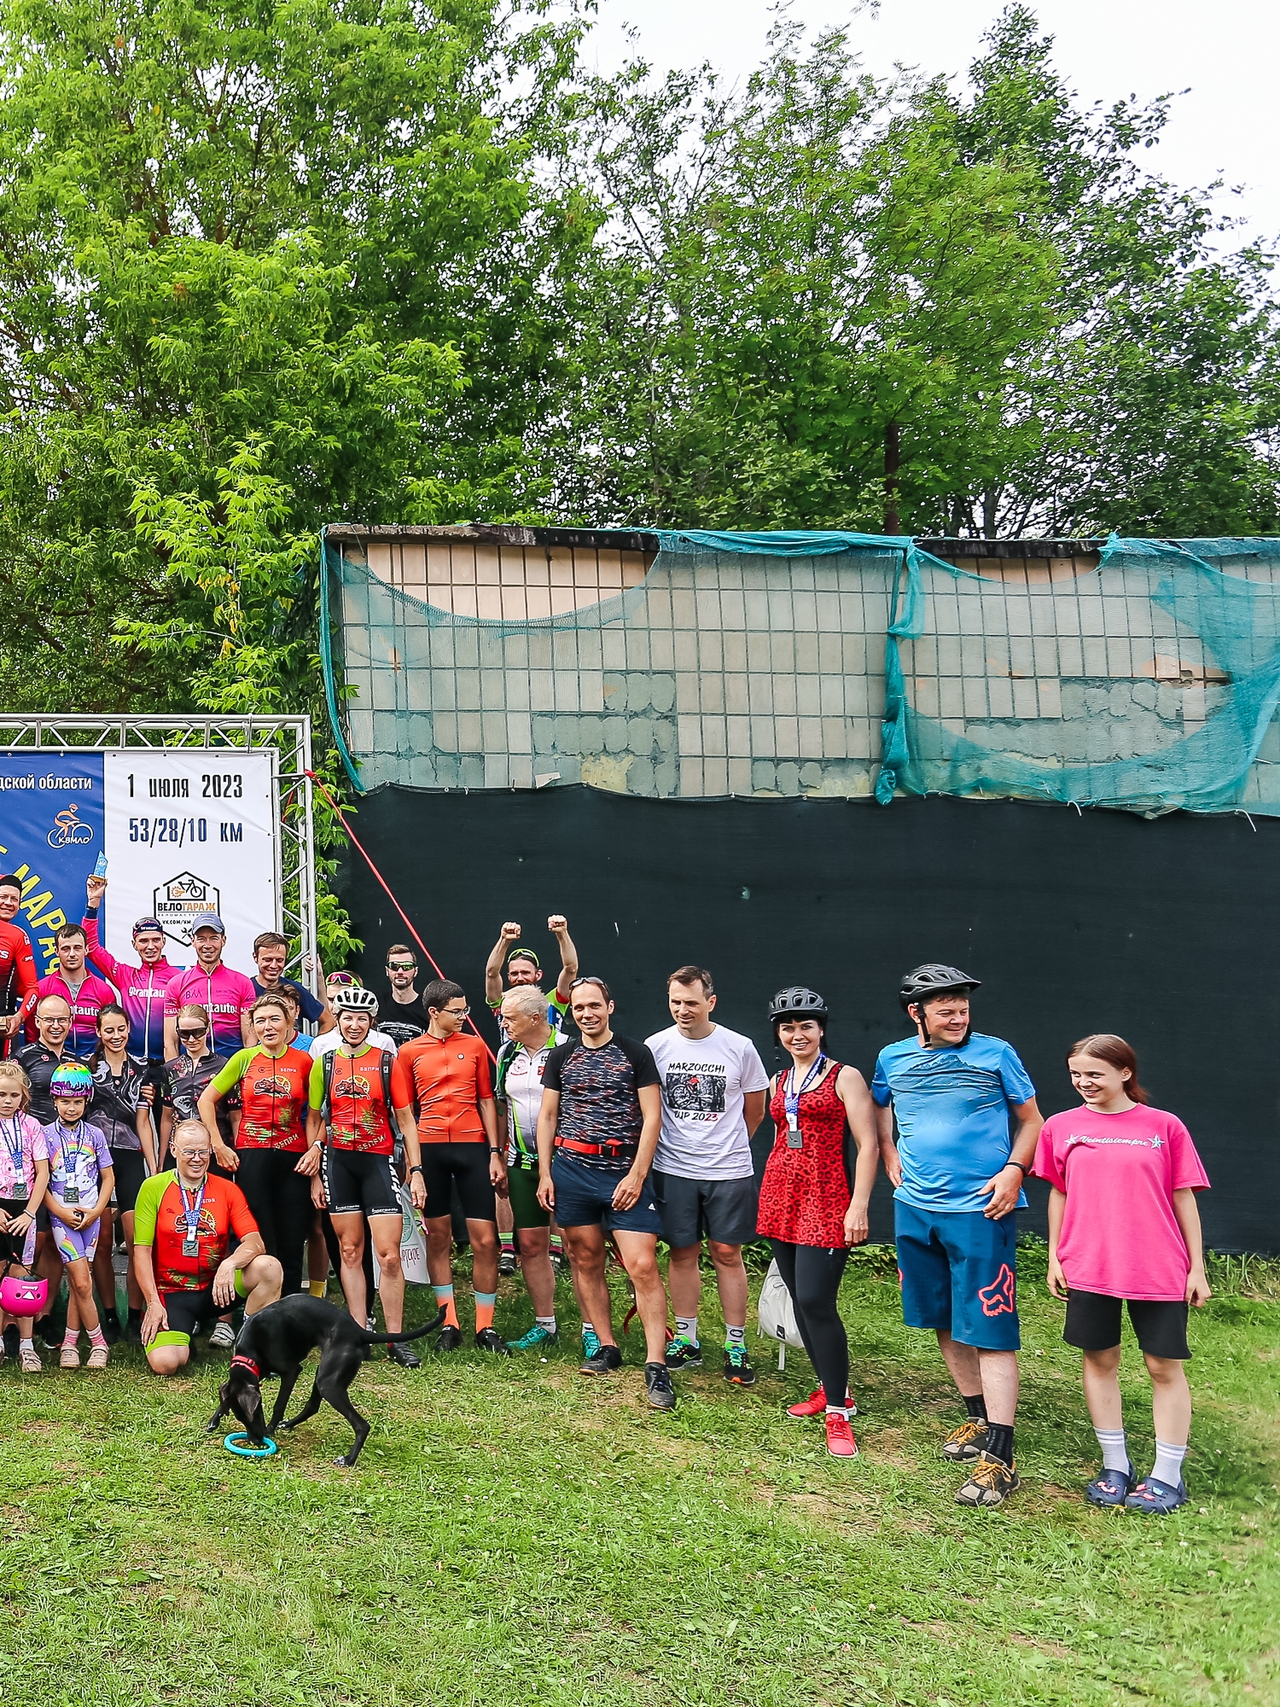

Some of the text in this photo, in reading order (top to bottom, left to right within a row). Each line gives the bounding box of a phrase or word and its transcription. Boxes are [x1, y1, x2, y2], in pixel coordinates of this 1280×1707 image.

[38, 773, 93, 790] области
[127, 774, 243, 798] 1 июля 2023
[129, 818, 208, 848] 53/28/10
[158, 902, 216, 911] ВЕЛОГАРАЖ
[668, 1062, 726, 1074] MARZOCCHI
[692, 1112, 719, 1122] 2023
